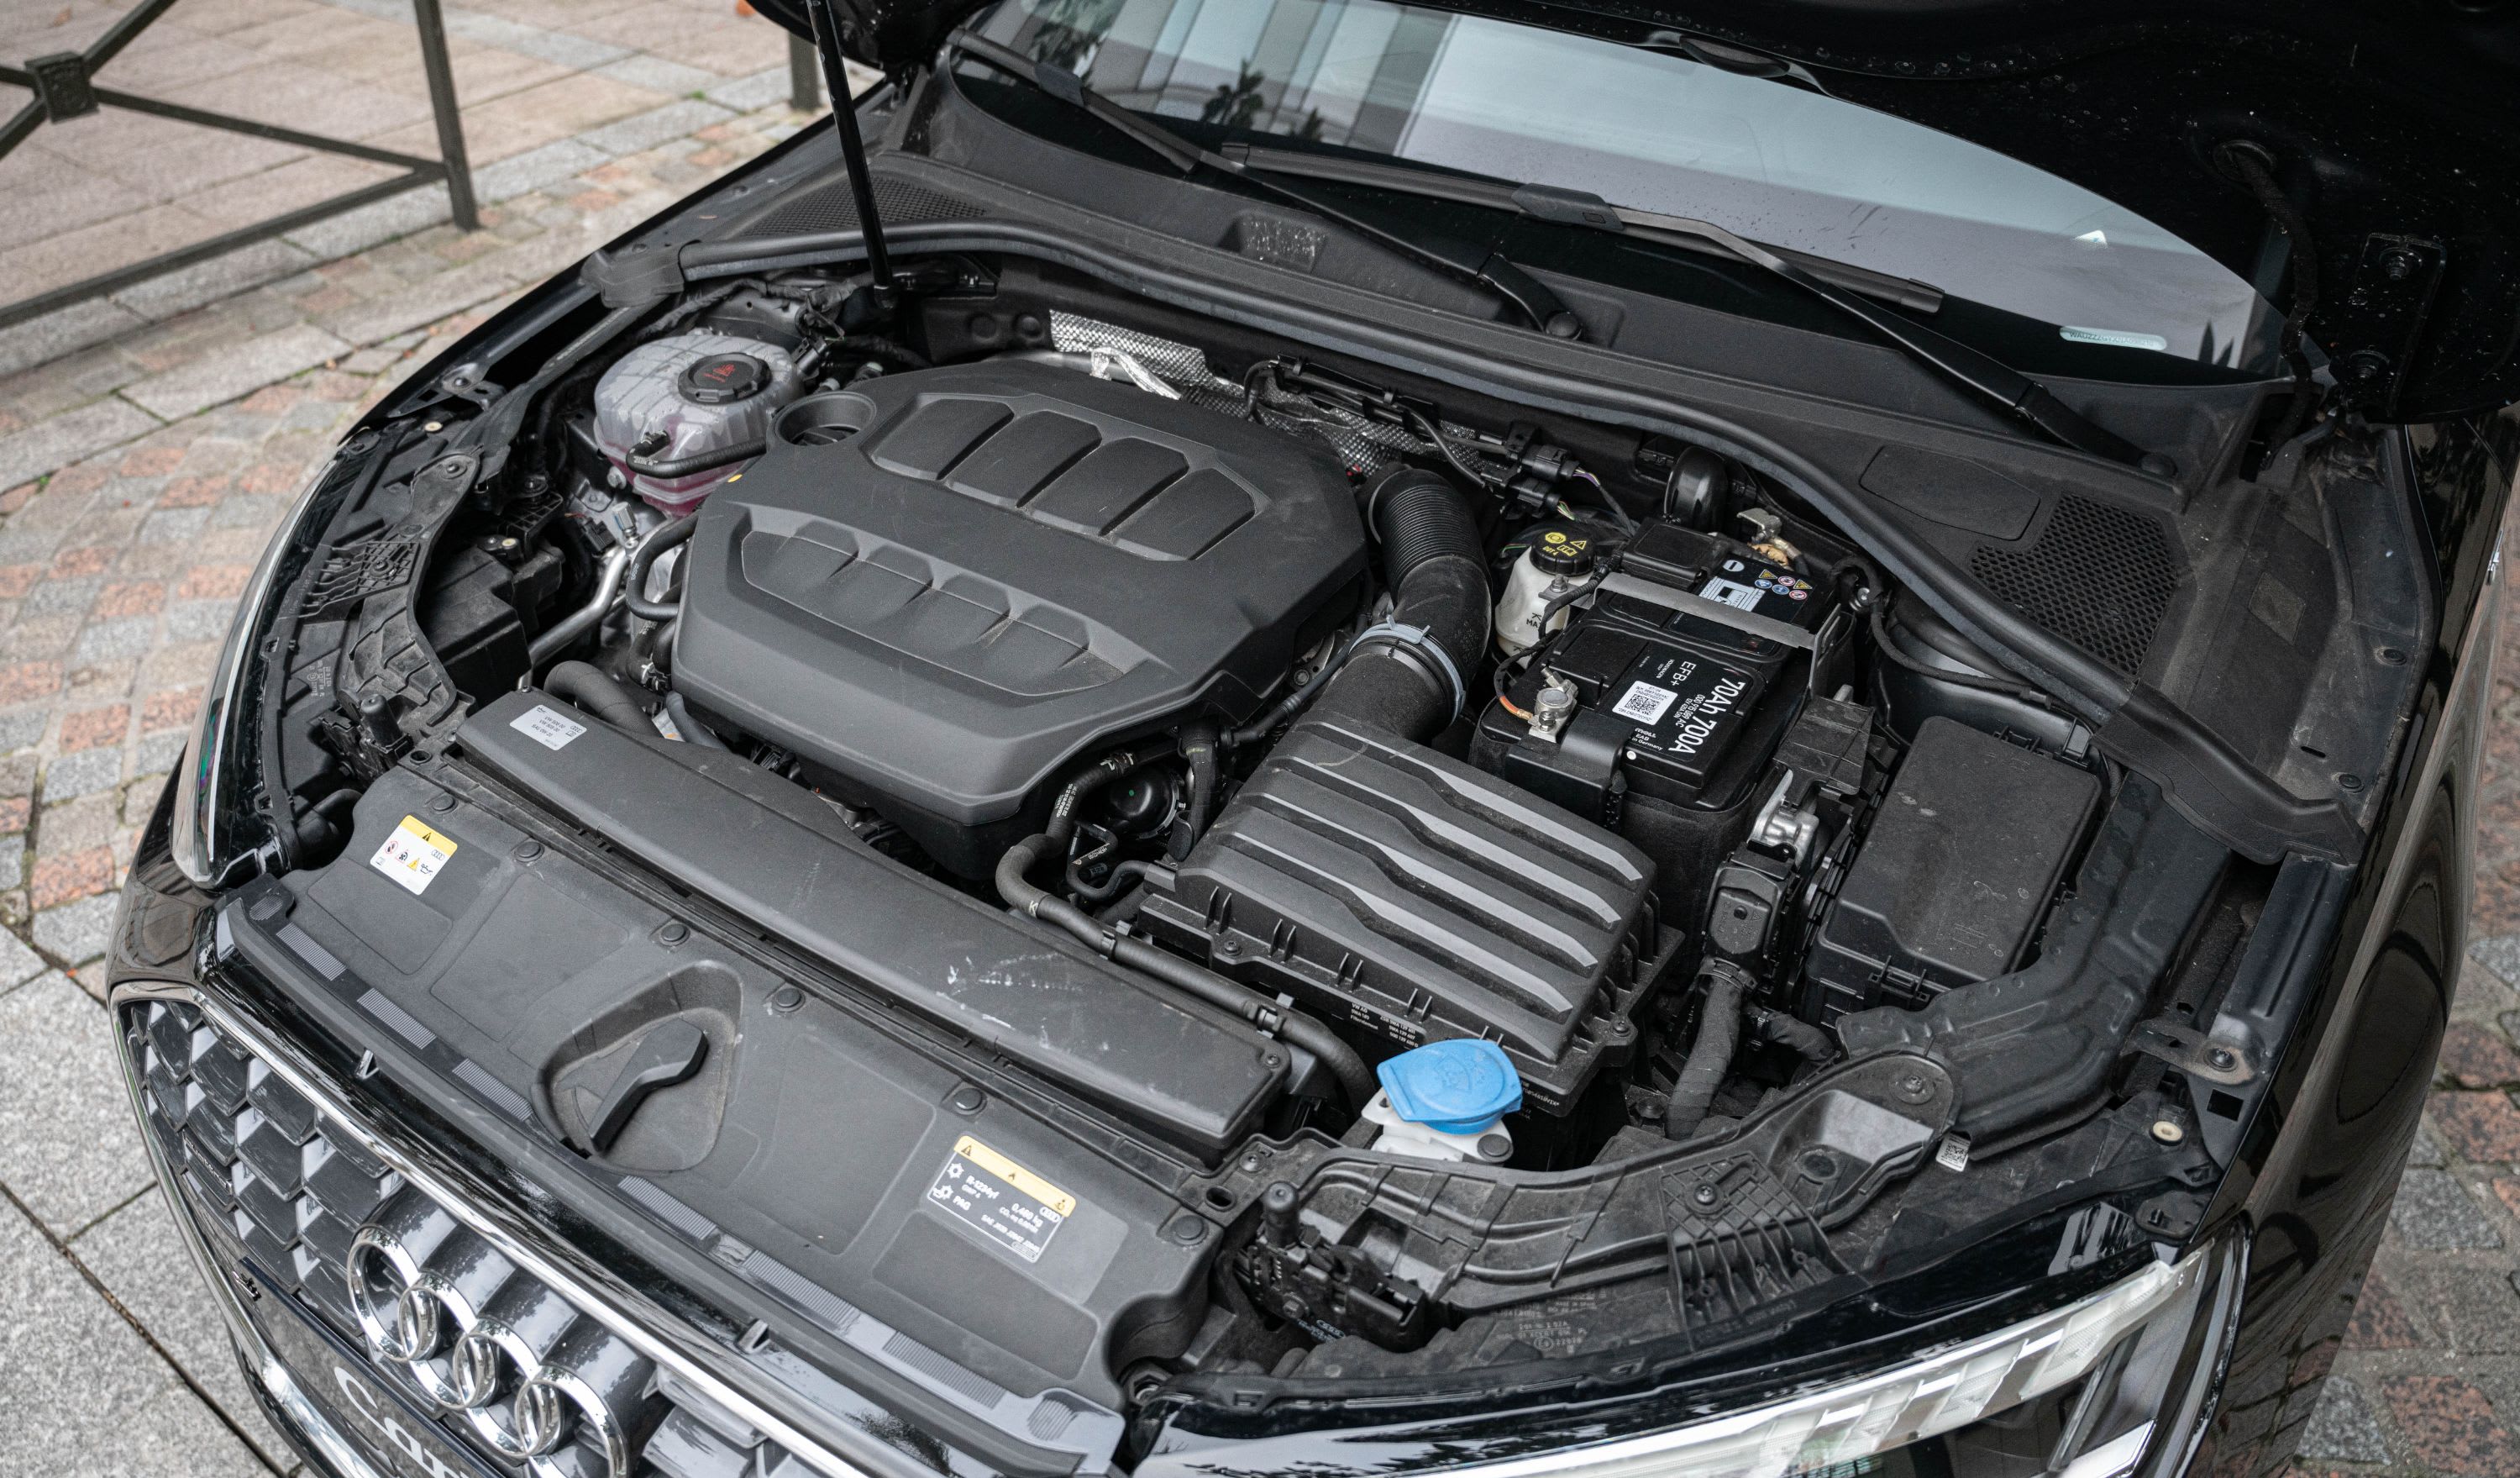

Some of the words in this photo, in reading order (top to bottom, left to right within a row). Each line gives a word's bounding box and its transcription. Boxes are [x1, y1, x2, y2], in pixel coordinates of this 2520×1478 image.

[1542, 545, 1556, 554] DOT
[1525, 619, 1541, 628] MA
[1656, 659, 1675, 679] VOLKSWAGEN
[1670, 660, 1697, 686] EFB+
[1698, 677, 1746, 714] 70Ah
[1675, 718, 1687, 728] AC
[1668, 715, 1718, 754] 700A
[1638, 738, 1663, 751] Germany
[966, 1176, 1000, 1199] R-1234yf
[953, 1195, 971, 1211] PAG
